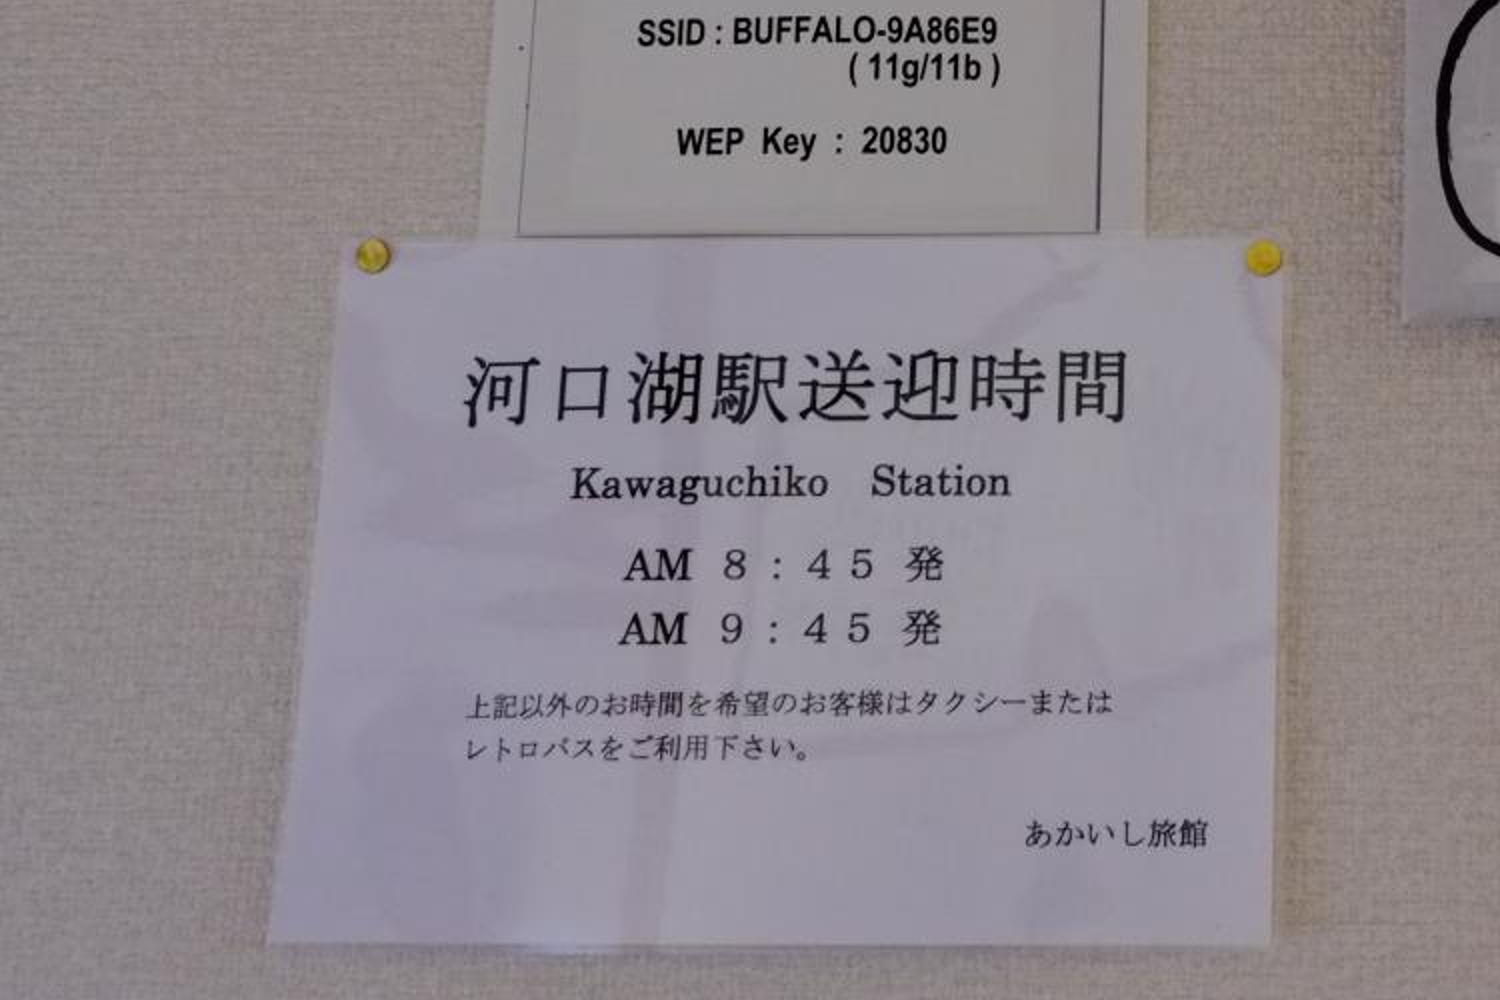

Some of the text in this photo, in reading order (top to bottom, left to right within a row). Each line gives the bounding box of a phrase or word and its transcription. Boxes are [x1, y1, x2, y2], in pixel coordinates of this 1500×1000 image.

[732, 14, 998, 46] BUFFALO-9A86E9
[676, 126, 745, 157] WEP
[761, 125, 817, 163] Key
[860, 125, 948, 155] 20830
[463, 347, 1127, 429] 河口湖駅送迎時間
[569, 463, 1012, 506] Kawaguchiko Station
[622, 547, 694, 582] AM
[617, 611, 689, 646] AM
[466, 689, 1113, 721] 上記以外のお時間を希望のお客様はタクシーまたは
[1025, 818, 1209, 849] あかいし旅館
